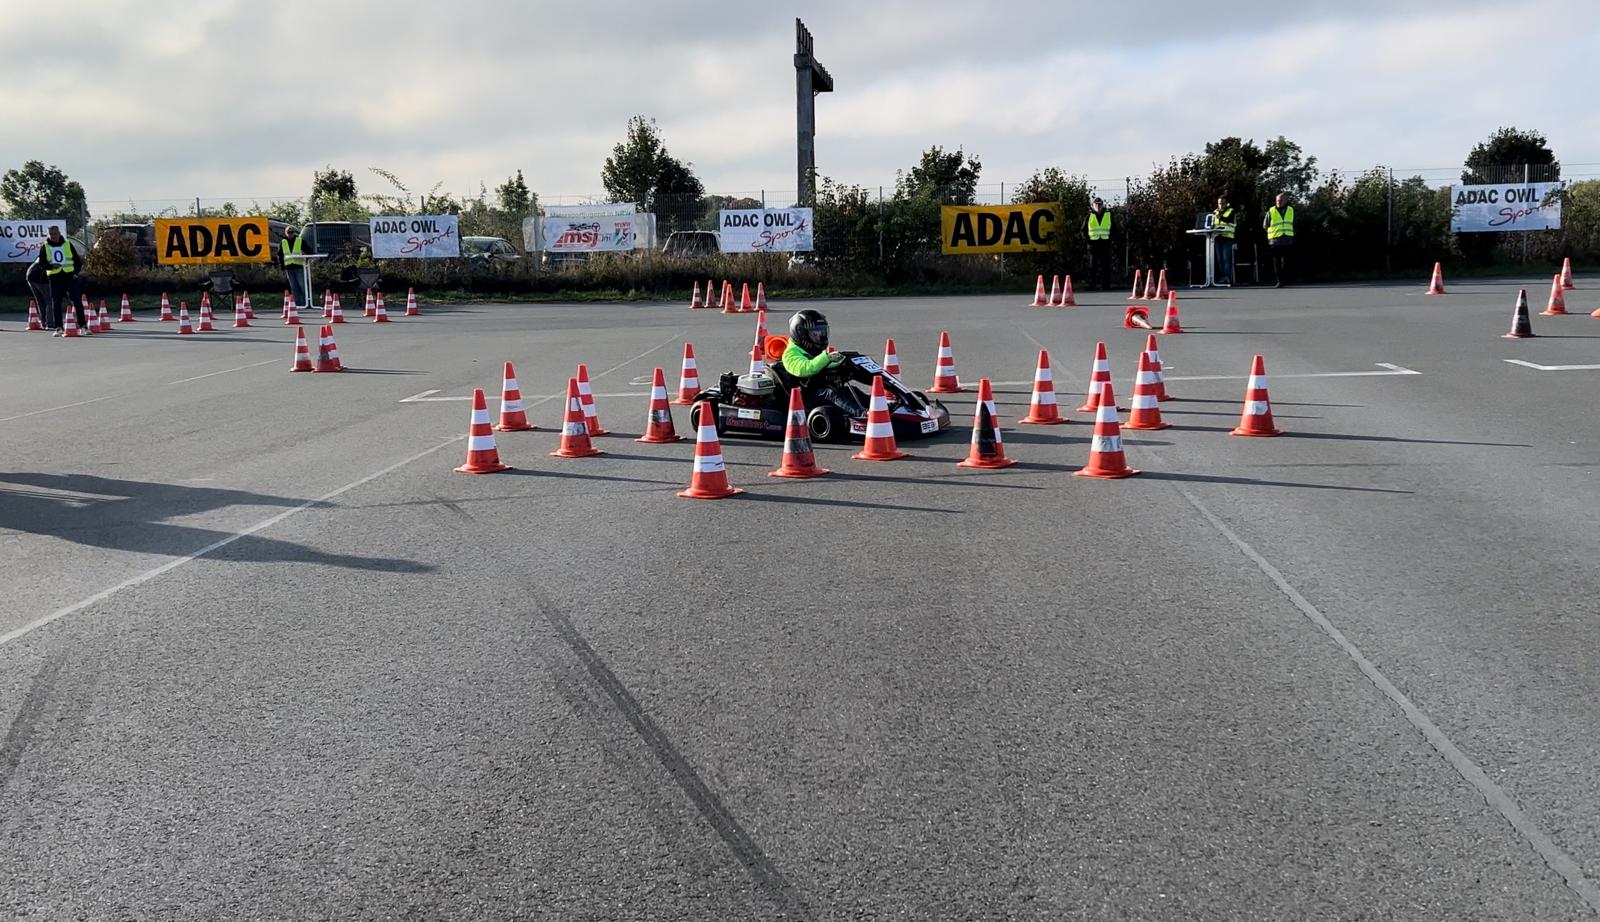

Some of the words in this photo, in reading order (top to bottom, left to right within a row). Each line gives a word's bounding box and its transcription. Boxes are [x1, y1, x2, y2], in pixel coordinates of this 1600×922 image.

[1455, 189, 1498, 205] ADAC
[1505, 188, 1540, 203] OWL
[723, 212, 760, 228] ADAC
[763, 212, 795, 227] OWL
[1488, 203, 1553, 226] Spor
[17, 225, 48, 238] OWL
[373, 220, 407, 234] ADAC
[410, 219, 440, 233] OWL
[751, 219, 808, 249] Sport
[950, 209, 1055, 248] ADAC
[165, 222, 263, 258] ADAC
[400, 227, 455, 254] Sport
